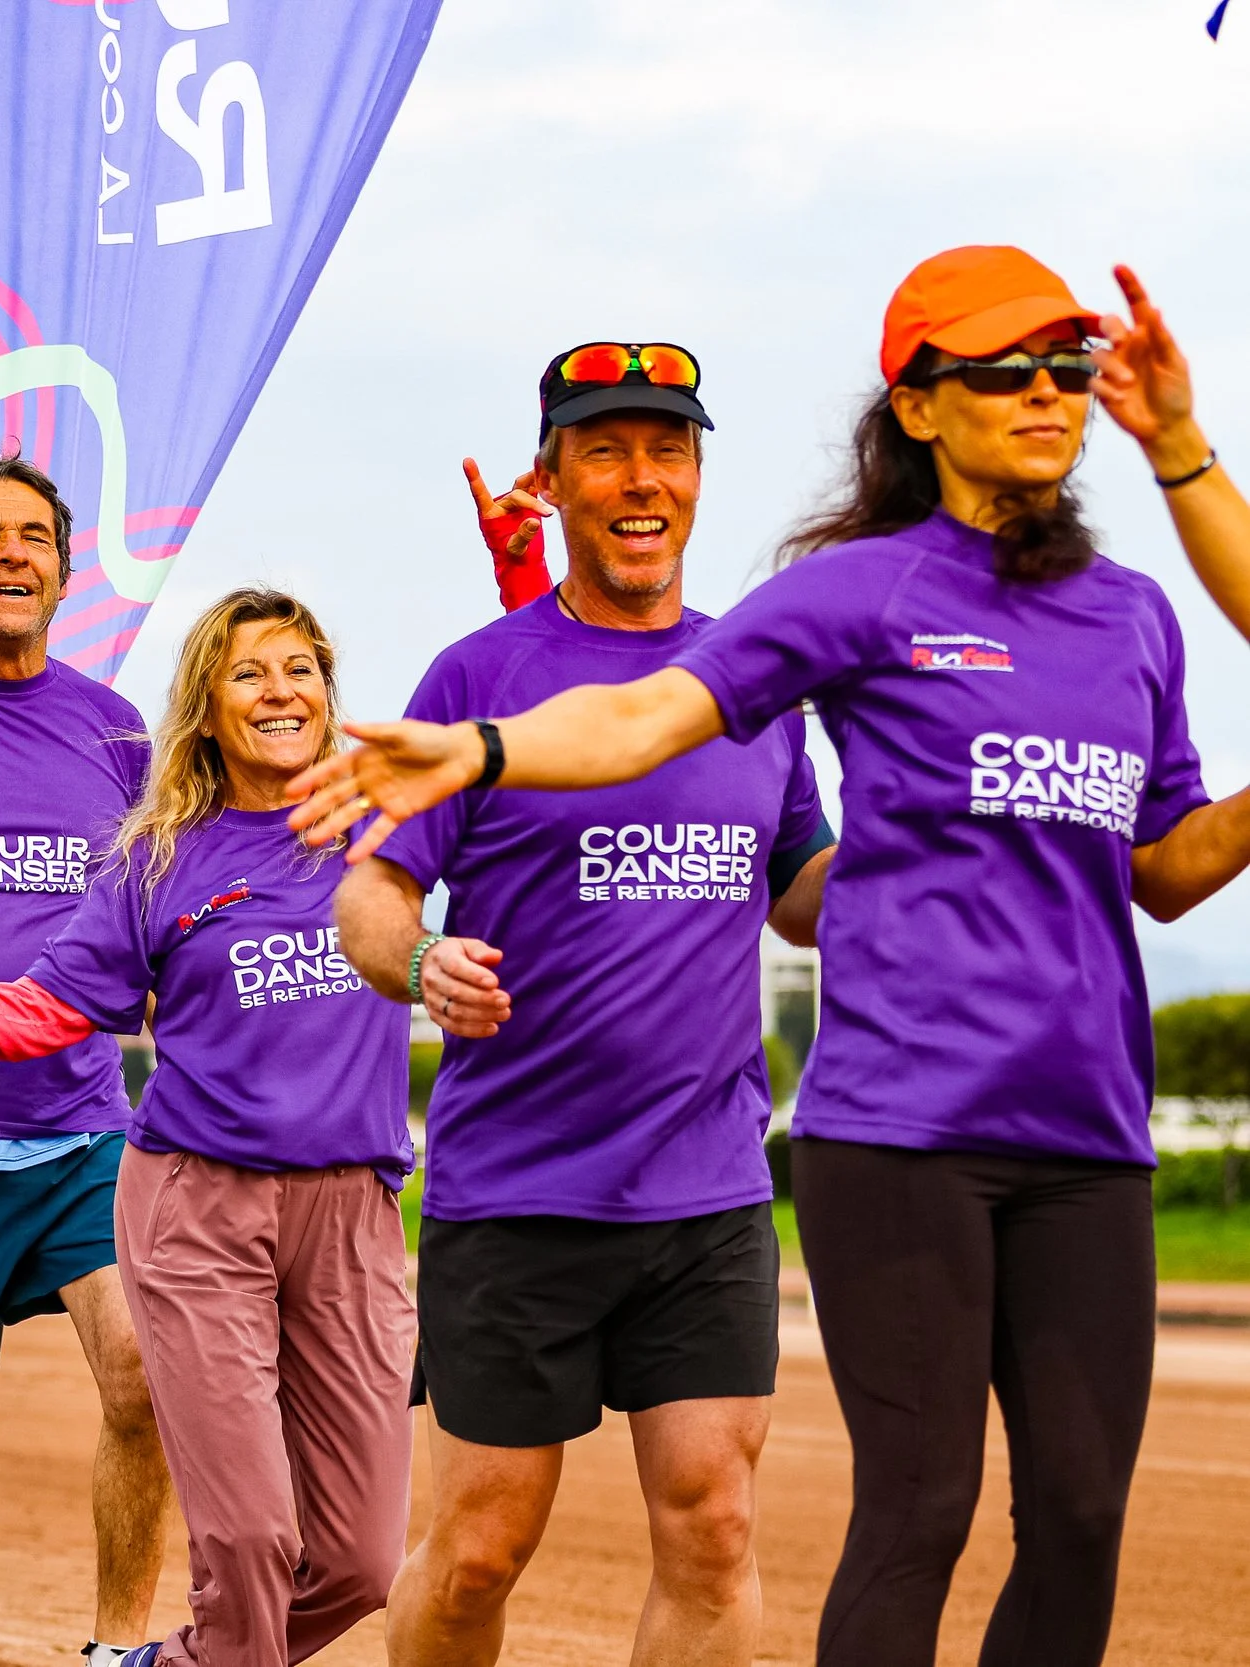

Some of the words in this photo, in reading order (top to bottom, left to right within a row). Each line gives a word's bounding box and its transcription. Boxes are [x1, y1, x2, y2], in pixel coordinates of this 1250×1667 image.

[911, 647, 1012, 668] Runfest
[969, 731, 1146, 793] COURIR
[969, 799, 1007, 816] SE
[579, 823, 758, 856] COURIR
[579, 854, 754, 885] DANSER
[579, 885, 611, 902] SE
[617, 884, 751, 902] RETROUVER
[233, 953, 360, 995] DANS
[239, 991, 267, 1010] SE
[271, 976, 367, 1004] RETROU
